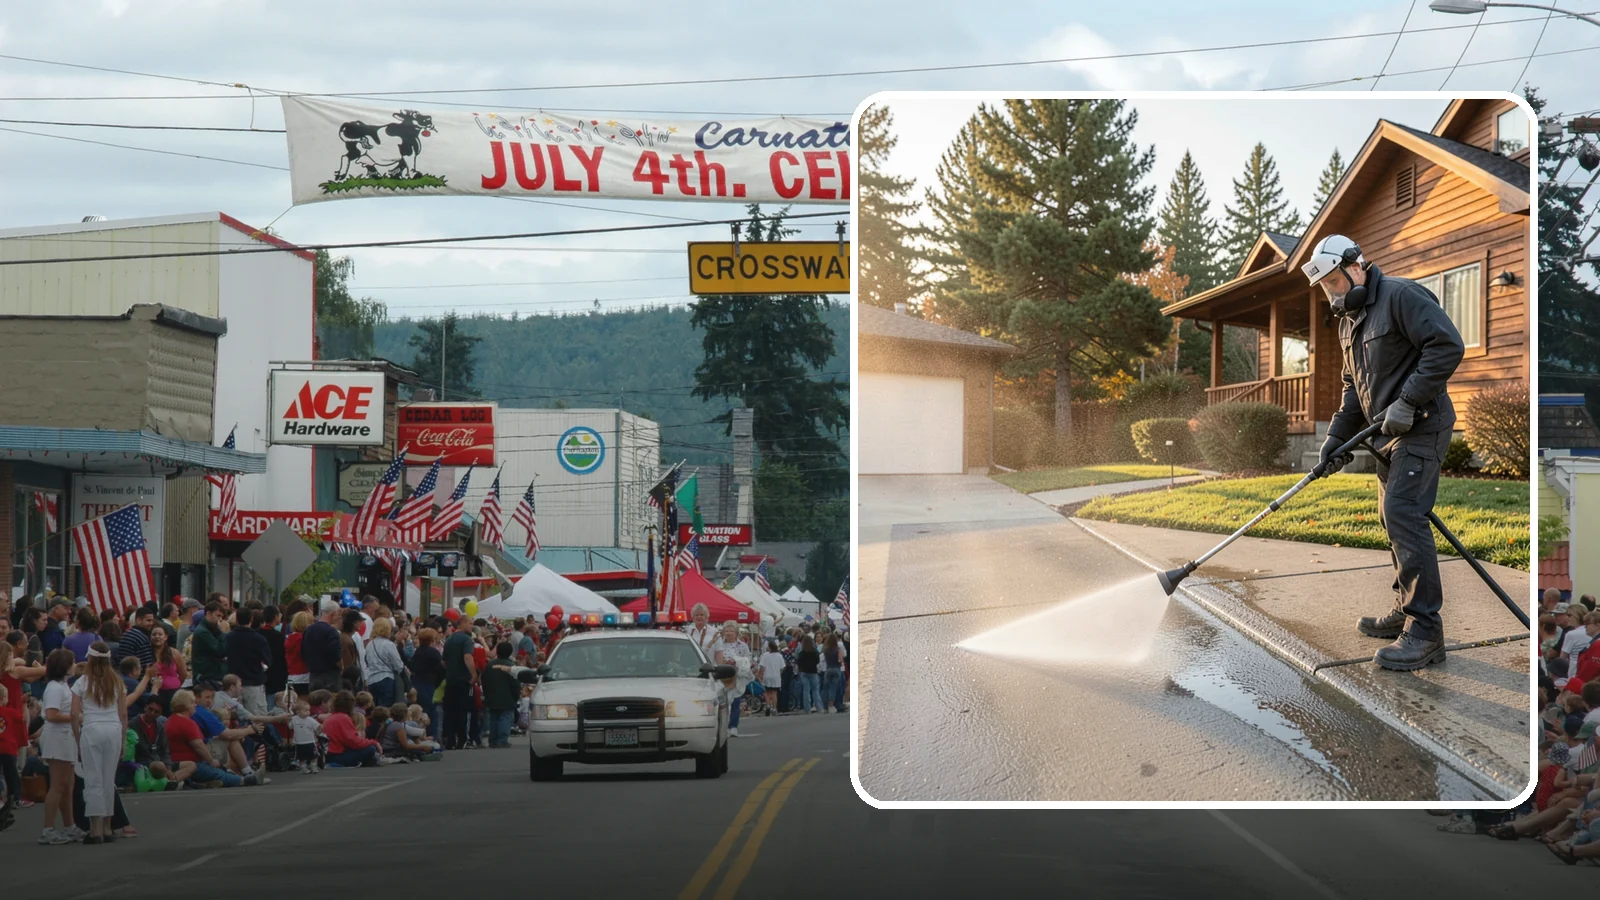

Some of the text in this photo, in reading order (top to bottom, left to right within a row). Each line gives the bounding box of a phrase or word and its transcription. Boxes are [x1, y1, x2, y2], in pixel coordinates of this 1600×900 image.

[480, 141, 605, 192] JULY
[632, 150, 747, 198] 4th.
[697, 254, 850, 280] CROSSWA
[283, 380, 374, 419] ACE
[406, 409, 485, 421] CEDAR LOG
[283, 421, 371, 436] Hardware
[416, 428, 477, 447] Coca-Cola
[353, 467, 385, 485] Simpl
[95, 485, 124, 494] Vincent
[126, 486, 135, 494] de
[138, 486, 155, 495] Paul
[81, 503, 154, 521] THT
[688, 527, 741, 535] CRNATION
[699, 535, 730, 544] GLASS
